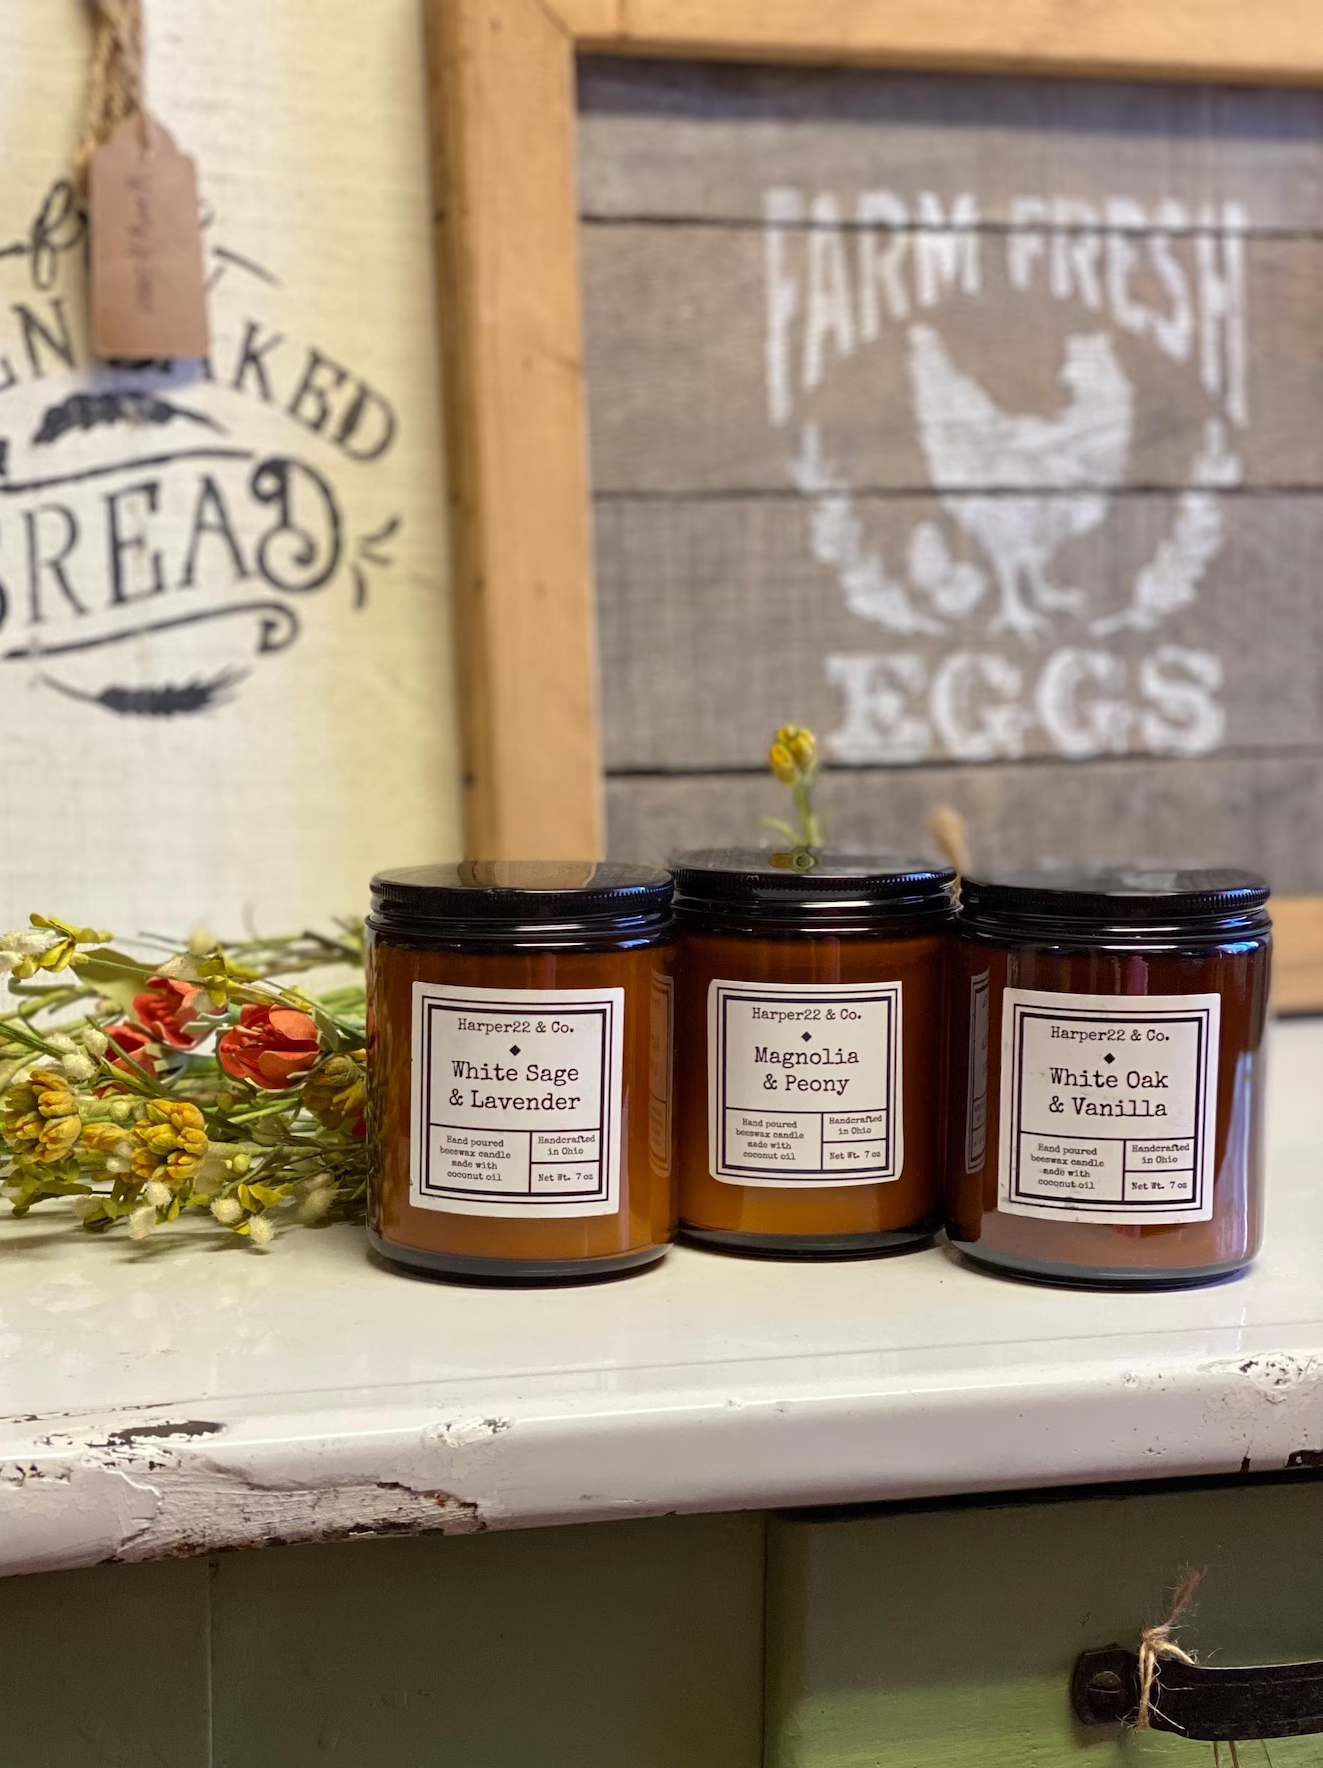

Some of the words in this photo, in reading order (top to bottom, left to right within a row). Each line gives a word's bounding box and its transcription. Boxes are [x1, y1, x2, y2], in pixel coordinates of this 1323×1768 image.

[764, 190, 980, 428] FARM
[1007, 194, 1248, 428] FRESH
[0, 456, 342, 630] READ
[824, 644, 1226, 764] EGGS
[752, 1007, 821, 1023] Harper22
[825, 1009, 836, 1020] &
[840, 1008, 862, 1020] Co.
[458, 1018, 531, 1035] Harper22
[535, 1021, 547, 1033] &
[551, 1021, 574, 1033] Co.
[1051, 1026, 1126, 1042] Harper22
[1130, 1029, 1142, 1041] &
[1146, 1029, 1170, 1042] Co.
[754, 1046, 859, 1069] Magnolia
[452, 1060, 518, 1081] White
[526, 1064, 579, 1086] Sage
[1050, 1067, 1118, 1088] White
[1126, 1071, 1169, 1089] Oak
[763, 1073, 778, 1090] &
[785, 1075, 850, 1095] Peony
[449, 1088, 463, 1107] &
[471, 1090, 581, 1110] Lavender
[1049, 1095, 1064, 1113] &
[1072, 1097, 1168, 1117] Vanilla
[742, 1118, 763, 1127] Hand
[765, 1119, 797, 1129] poured
[829, 1115, 882, 1124] Handcrafted
[736, 1128, 770, 1138] beeswax
[773, 1130, 804, 1139] candle
[446, 1135, 468, 1147] Hand
[470, 1137, 504, 1149] poured
[538, 1135, 595, 1145] Handcrafted
[747, 1140, 768, 1149] made
[440, 1146, 476, 1158] beeswax
[478, 1149, 511, 1159] candle
[547, 1147, 559, 1156] in
[561, 1146, 584, 1155] Ohio
[1037, 1143, 1061, 1154] Hand
[1063, 1145, 1097, 1156] poured
[1132, 1143, 1189, 1153] Handcrafted
[743, 1150, 779, 1159] coconut
[781, 1152, 796, 1160] oil
[829, 1152, 845, 1160] Net
[1031, 1154, 1068, 1165] beeswax
[1071, 1157, 1104, 1168] candle
[1141, 1156, 1153, 1164] in
[1155, 1154, 1178, 1163] Ohio
[451, 1159, 473, 1169] made
[475, 1160, 497, 1170] with
[447, 1170, 484, 1181] coconut
[486, 1172, 502, 1181] oil
[538, 1173, 554, 1182] Net
[556, 1173, 570, 1182] Wt.
[576, 1172, 581, 1181] 7
[583, 1173, 593, 1181] oz
[1043, 1167, 1065, 1177] made
[1068, 1168, 1090, 1178] with
[1038, 1178, 1076, 1188] coconut
[1078, 1180, 1095, 1190] oil
[1132, 1181, 1148, 1191] Net
[1150, 1181, 1164, 1190] Wt.
[1170, 1181, 1176, 1189] 7
[1177, 1181, 1187, 1189] oz
